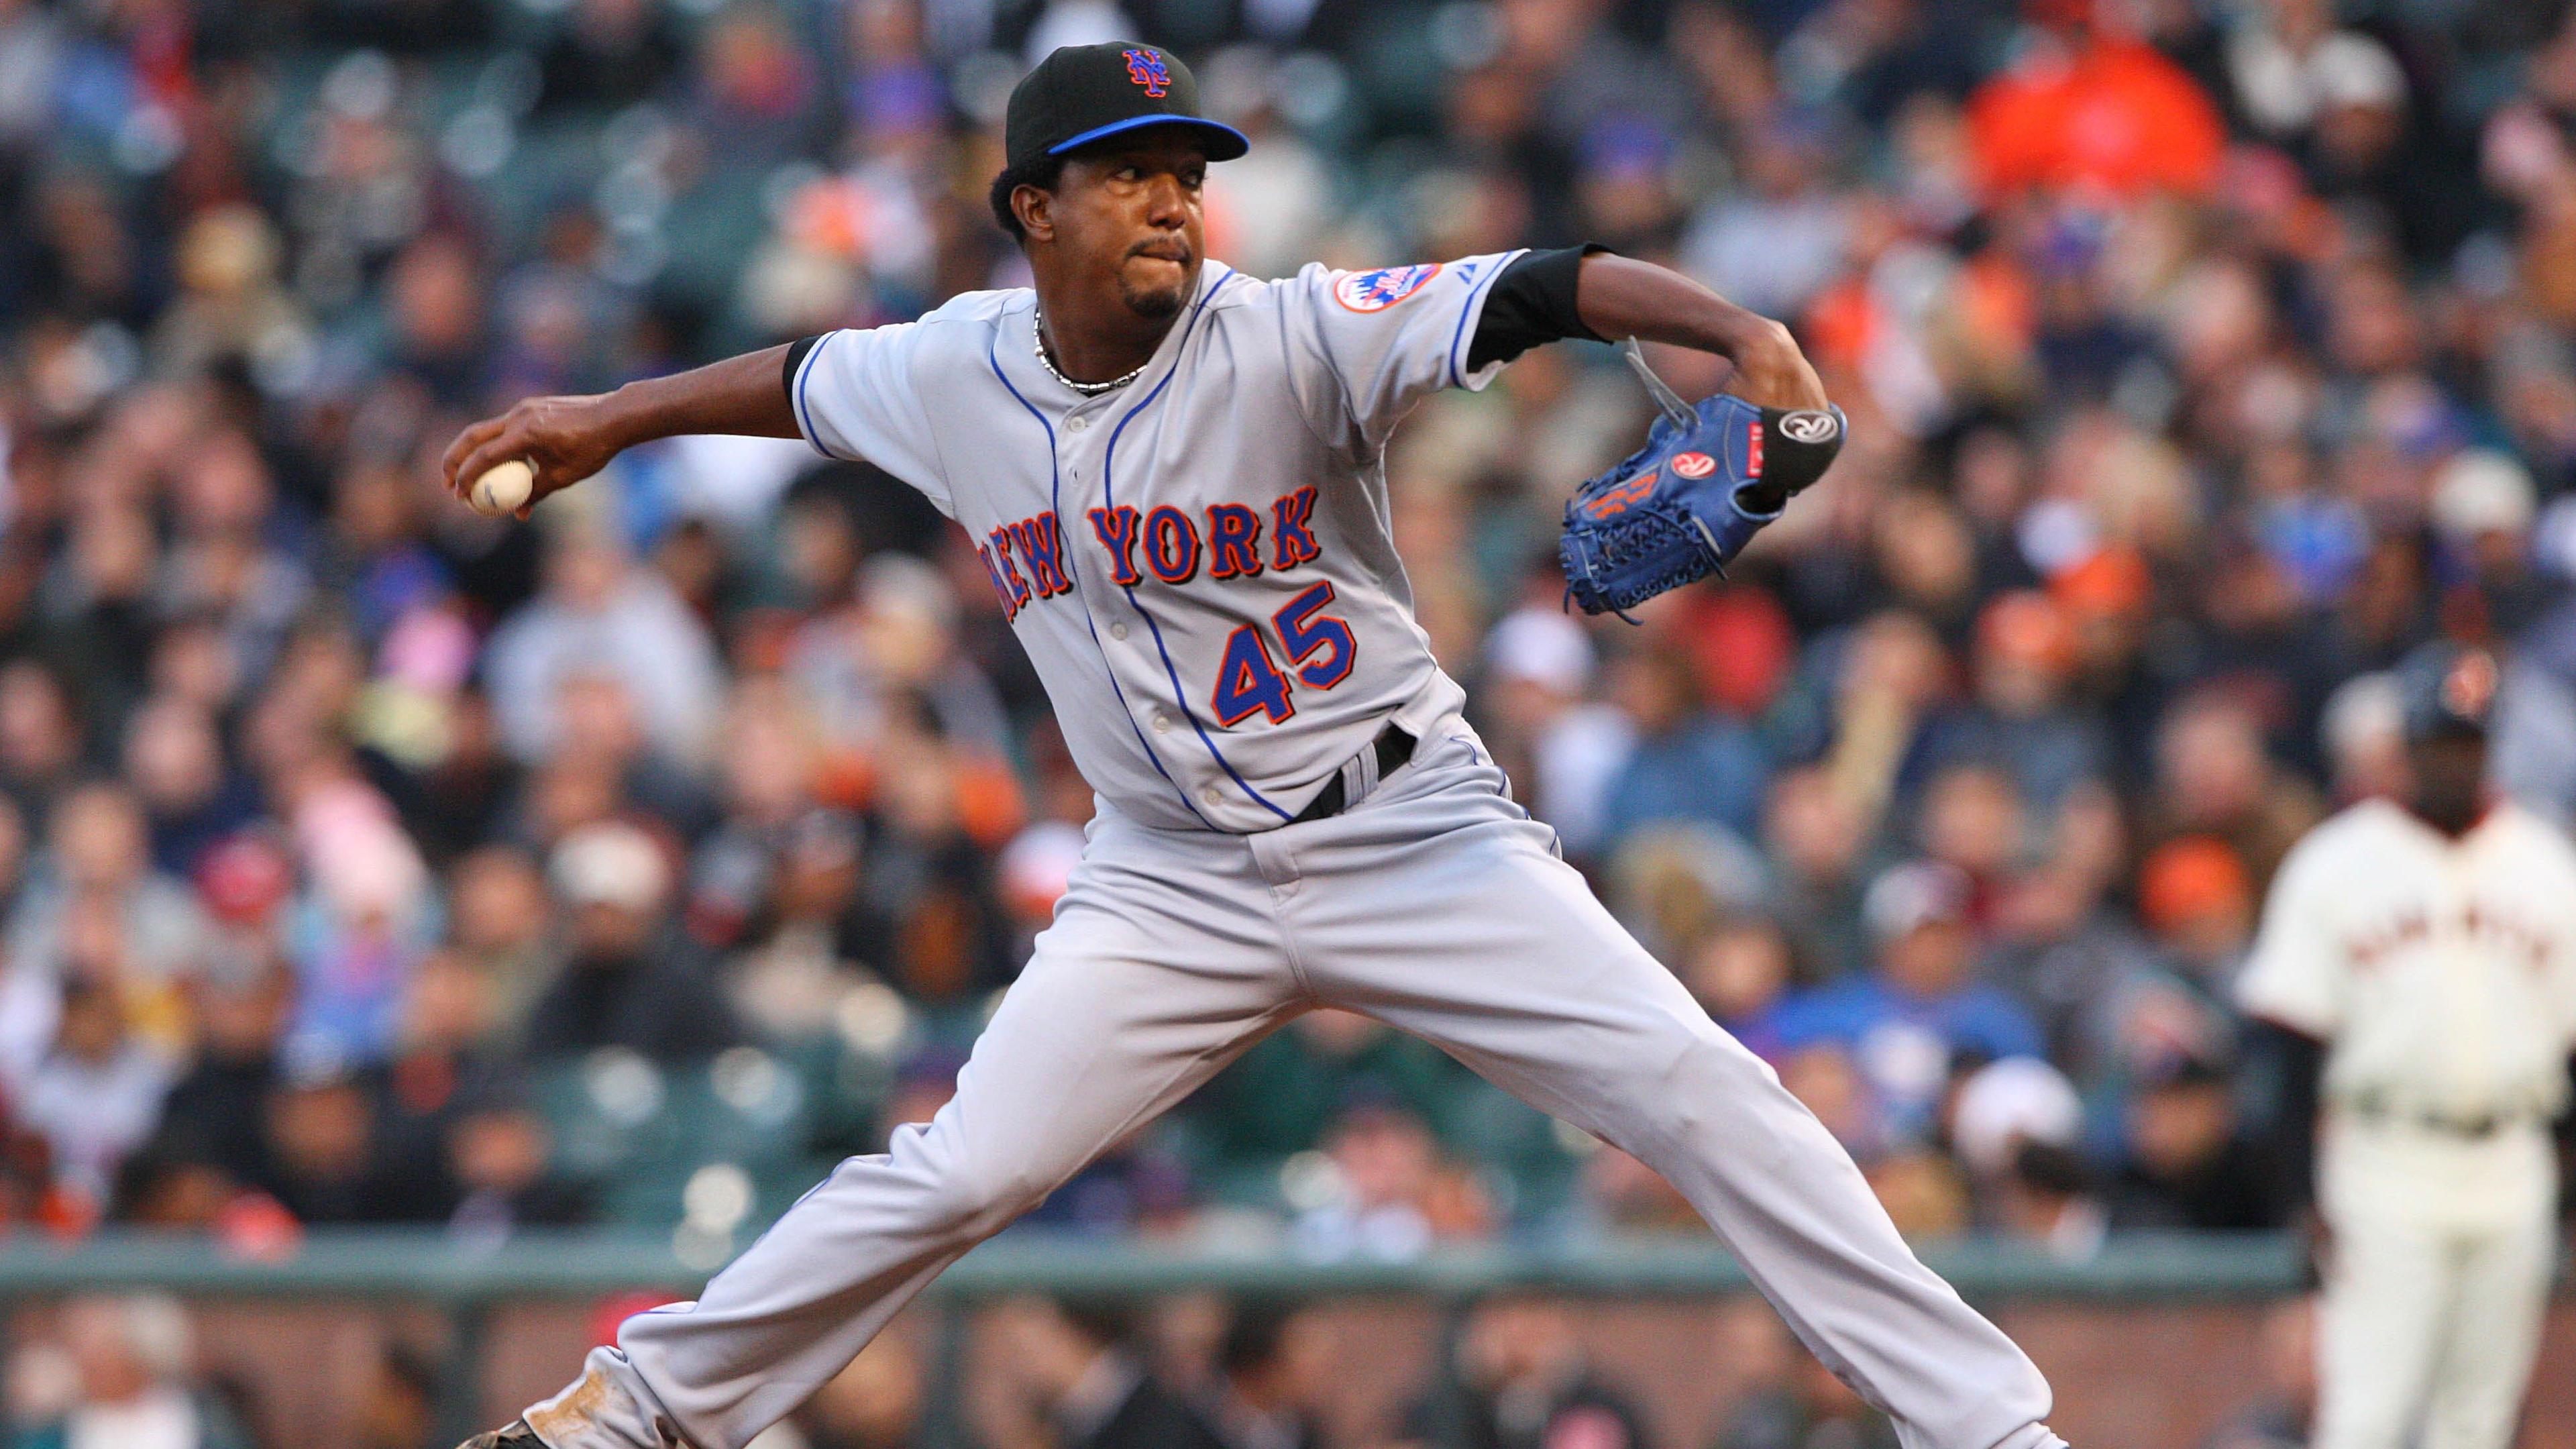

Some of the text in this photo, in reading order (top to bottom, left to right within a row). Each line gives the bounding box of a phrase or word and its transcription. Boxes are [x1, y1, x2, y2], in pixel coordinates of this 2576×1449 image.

[1122, 49, 1171, 98] NY
[1087, 485, 1321, 585] YORK
[1212, 580, 1357, 727] 45
